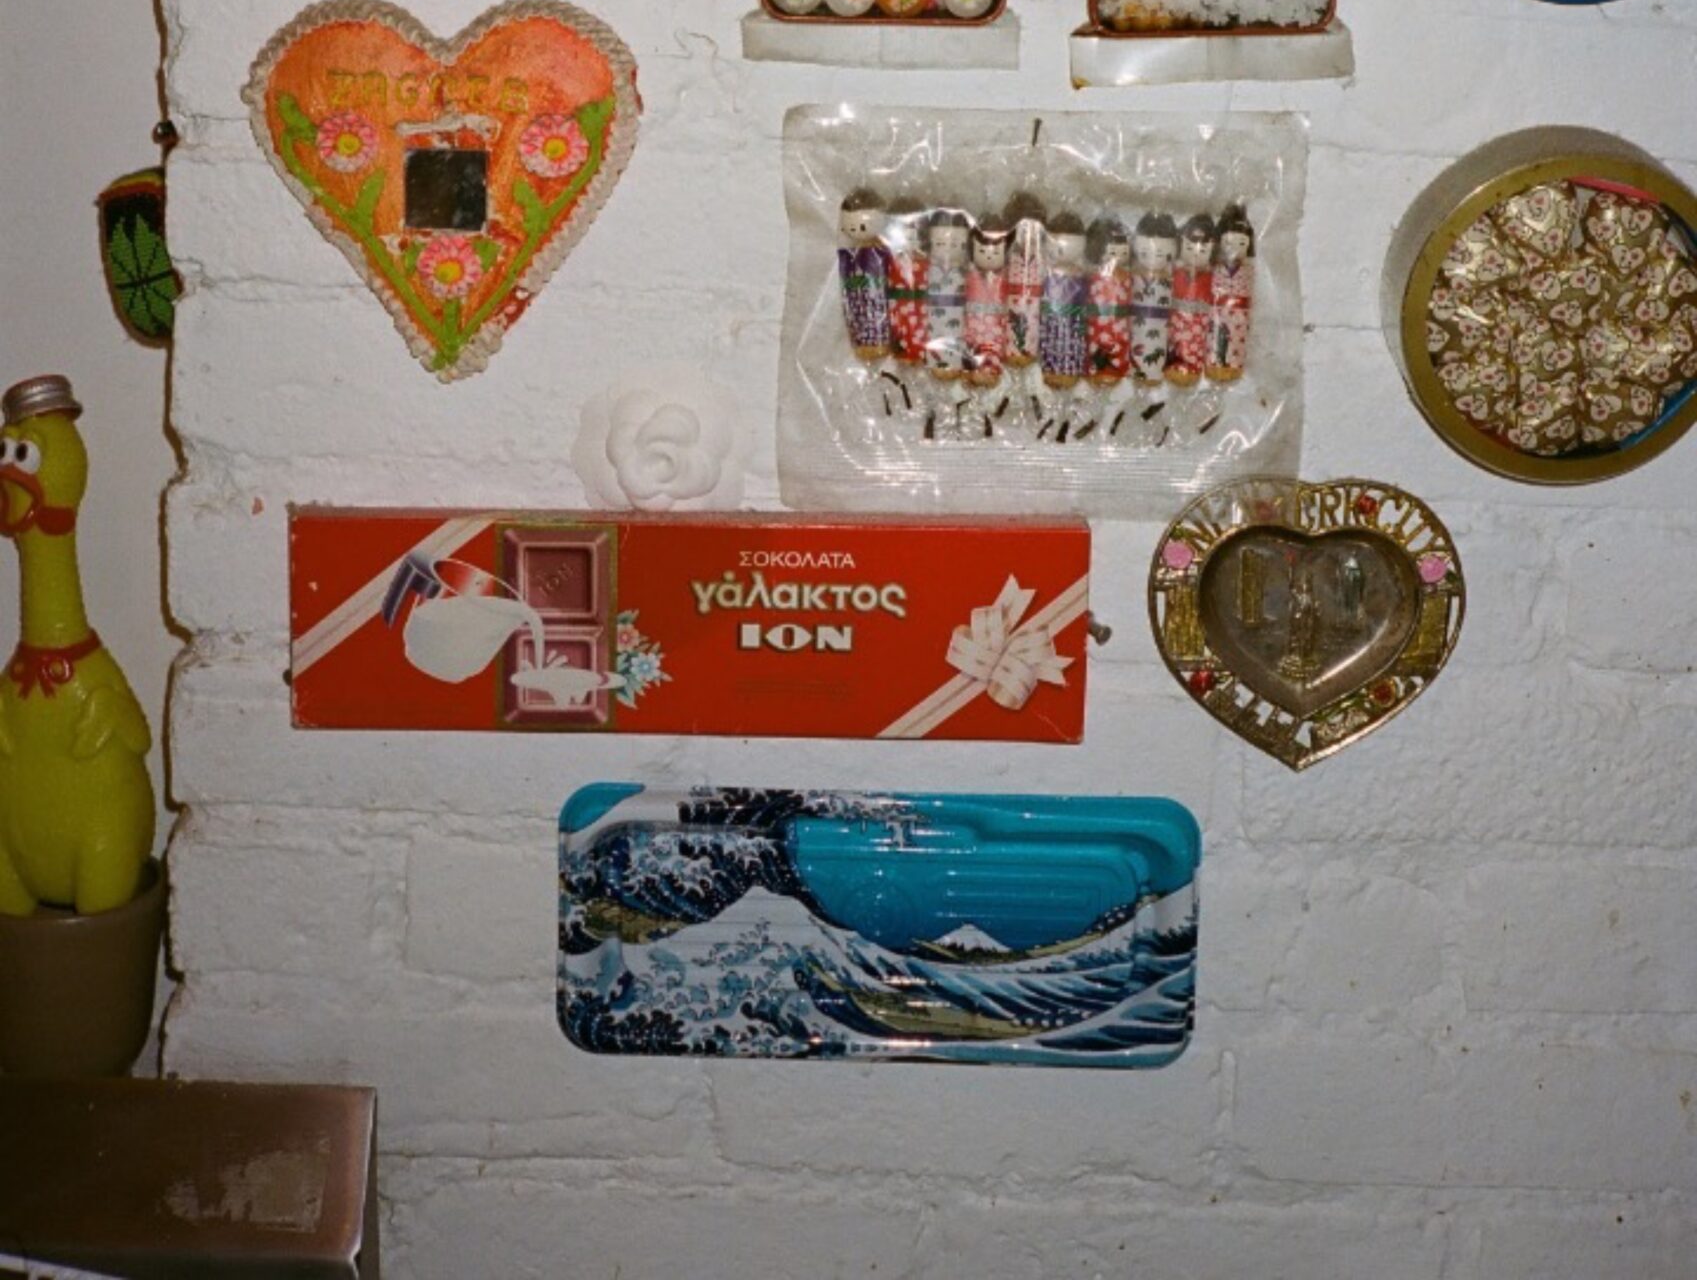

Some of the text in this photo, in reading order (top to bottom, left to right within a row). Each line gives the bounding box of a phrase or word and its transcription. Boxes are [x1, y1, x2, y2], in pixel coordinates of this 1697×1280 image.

[738, 550, 856, 569] ΣΟΚΟΛΑΤΑ
[691, 570, 907, 618] γάλακτος
[740, 623, 853, 651] ION
